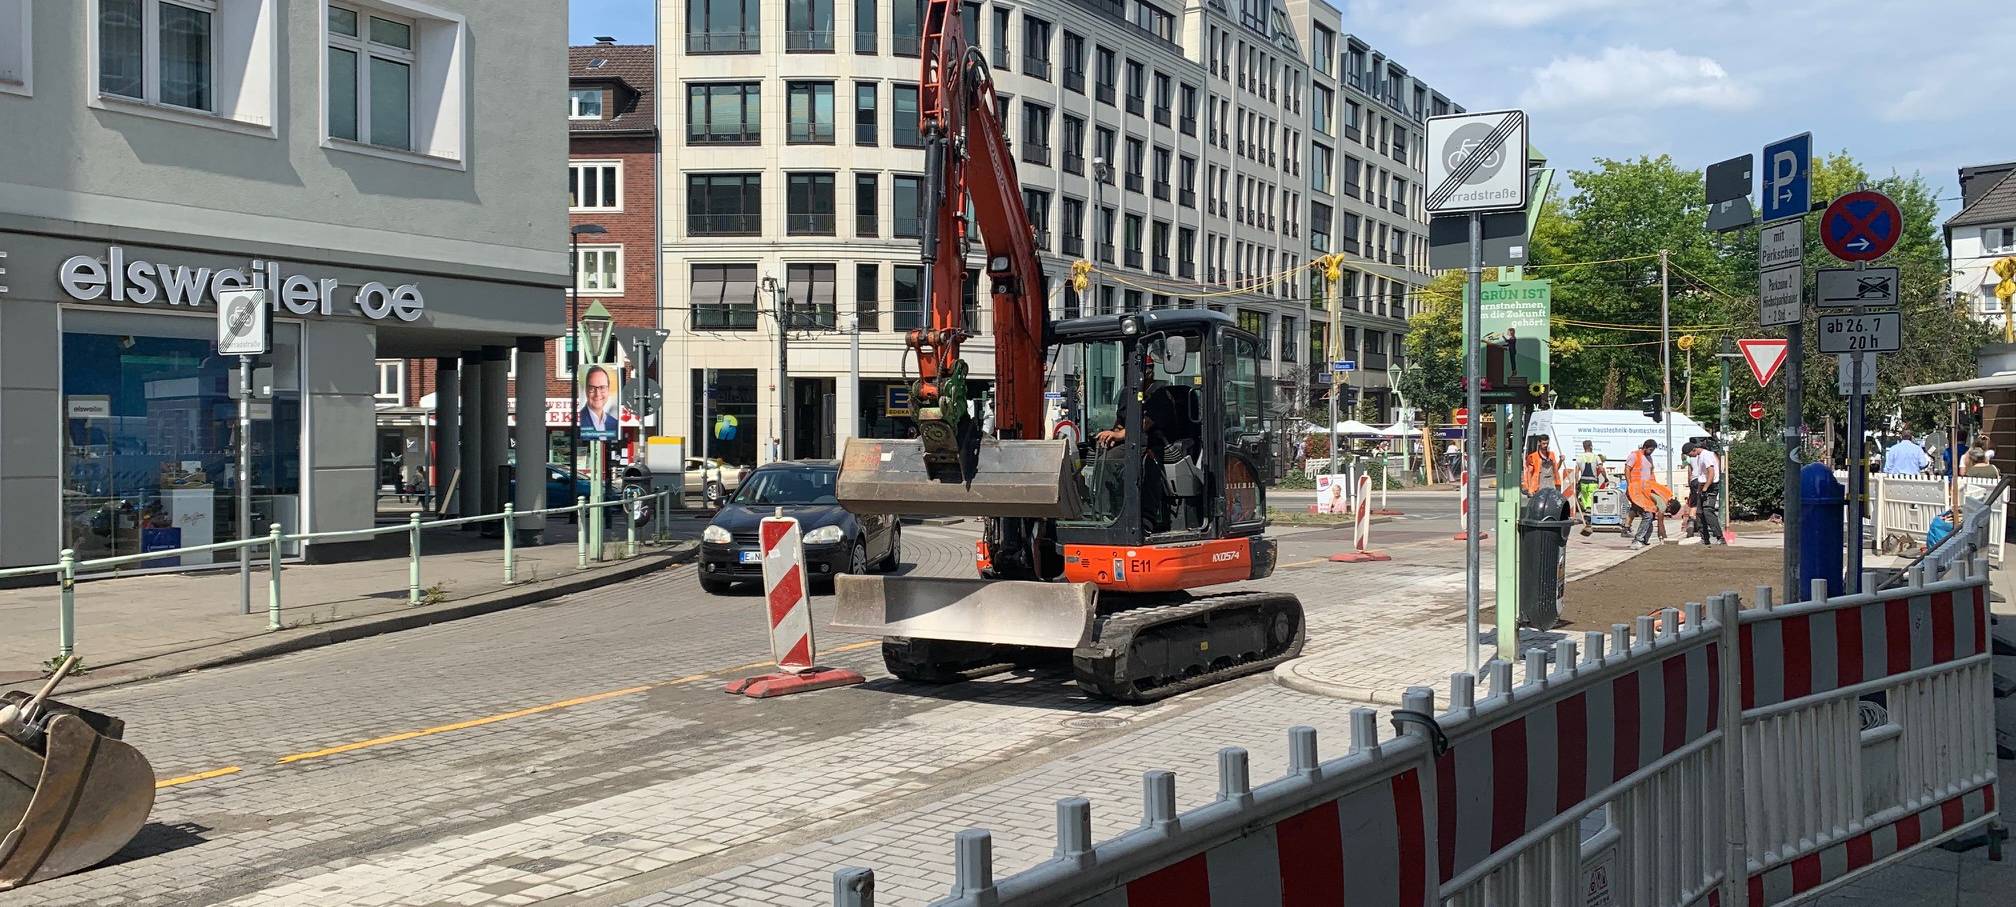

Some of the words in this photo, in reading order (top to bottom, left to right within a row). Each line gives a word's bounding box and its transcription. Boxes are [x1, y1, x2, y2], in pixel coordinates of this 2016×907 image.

[1772, 150, 1797, 210] P
[1449, 188, 1517, 202] rradstraße
[1773, 228, 1785, 242] mit
[1762, 244, 1800, 263] Parkschein
[60, 246, 337, 316] elsweiler
[1788, 273, 1792, 288] 2
[1481, 288, 1518, 300] GRÜN
[1523, 288, 1546, 299] IST
[1481, 301, 1546, 310] ernstnehmen,
[1491, 311, 1505, 319] die
[1506, 309, 1546, 318] Zukunft
[1512, 318, 1546, 328] gehört.
[1827, 319, 1843, 333] ab
[1847, 318, 1868, 333] 26.
[1873, 318, 1880, 332] 7
[1849, 336, 1866, 349] 20
[1870, 334, 1878, 348] h
[1131, 560, 1150, 572] E11
